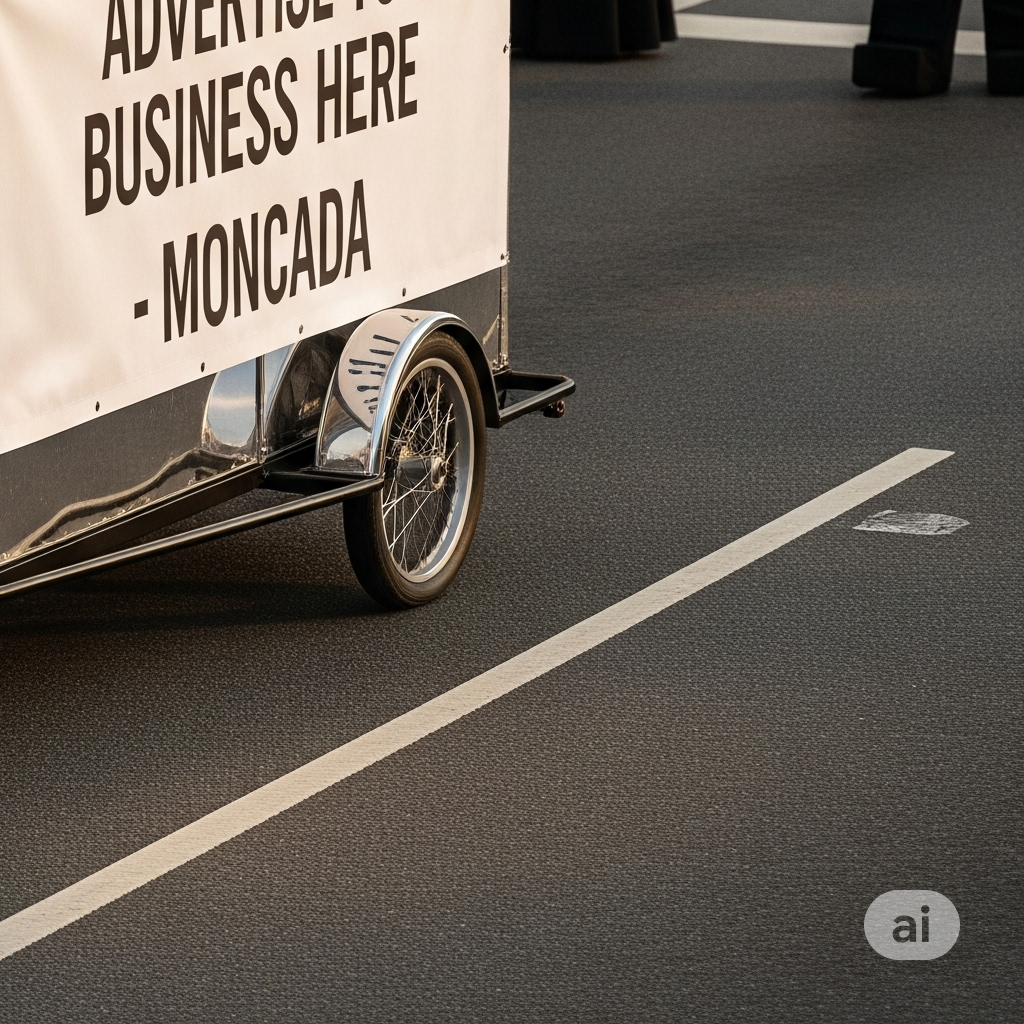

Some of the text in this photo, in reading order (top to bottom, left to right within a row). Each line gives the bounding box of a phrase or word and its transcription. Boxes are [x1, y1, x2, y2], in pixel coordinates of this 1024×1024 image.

[84, 21, 419, 217] BUSINESS HERE
[162, 178, 372, 343] MONCADA
